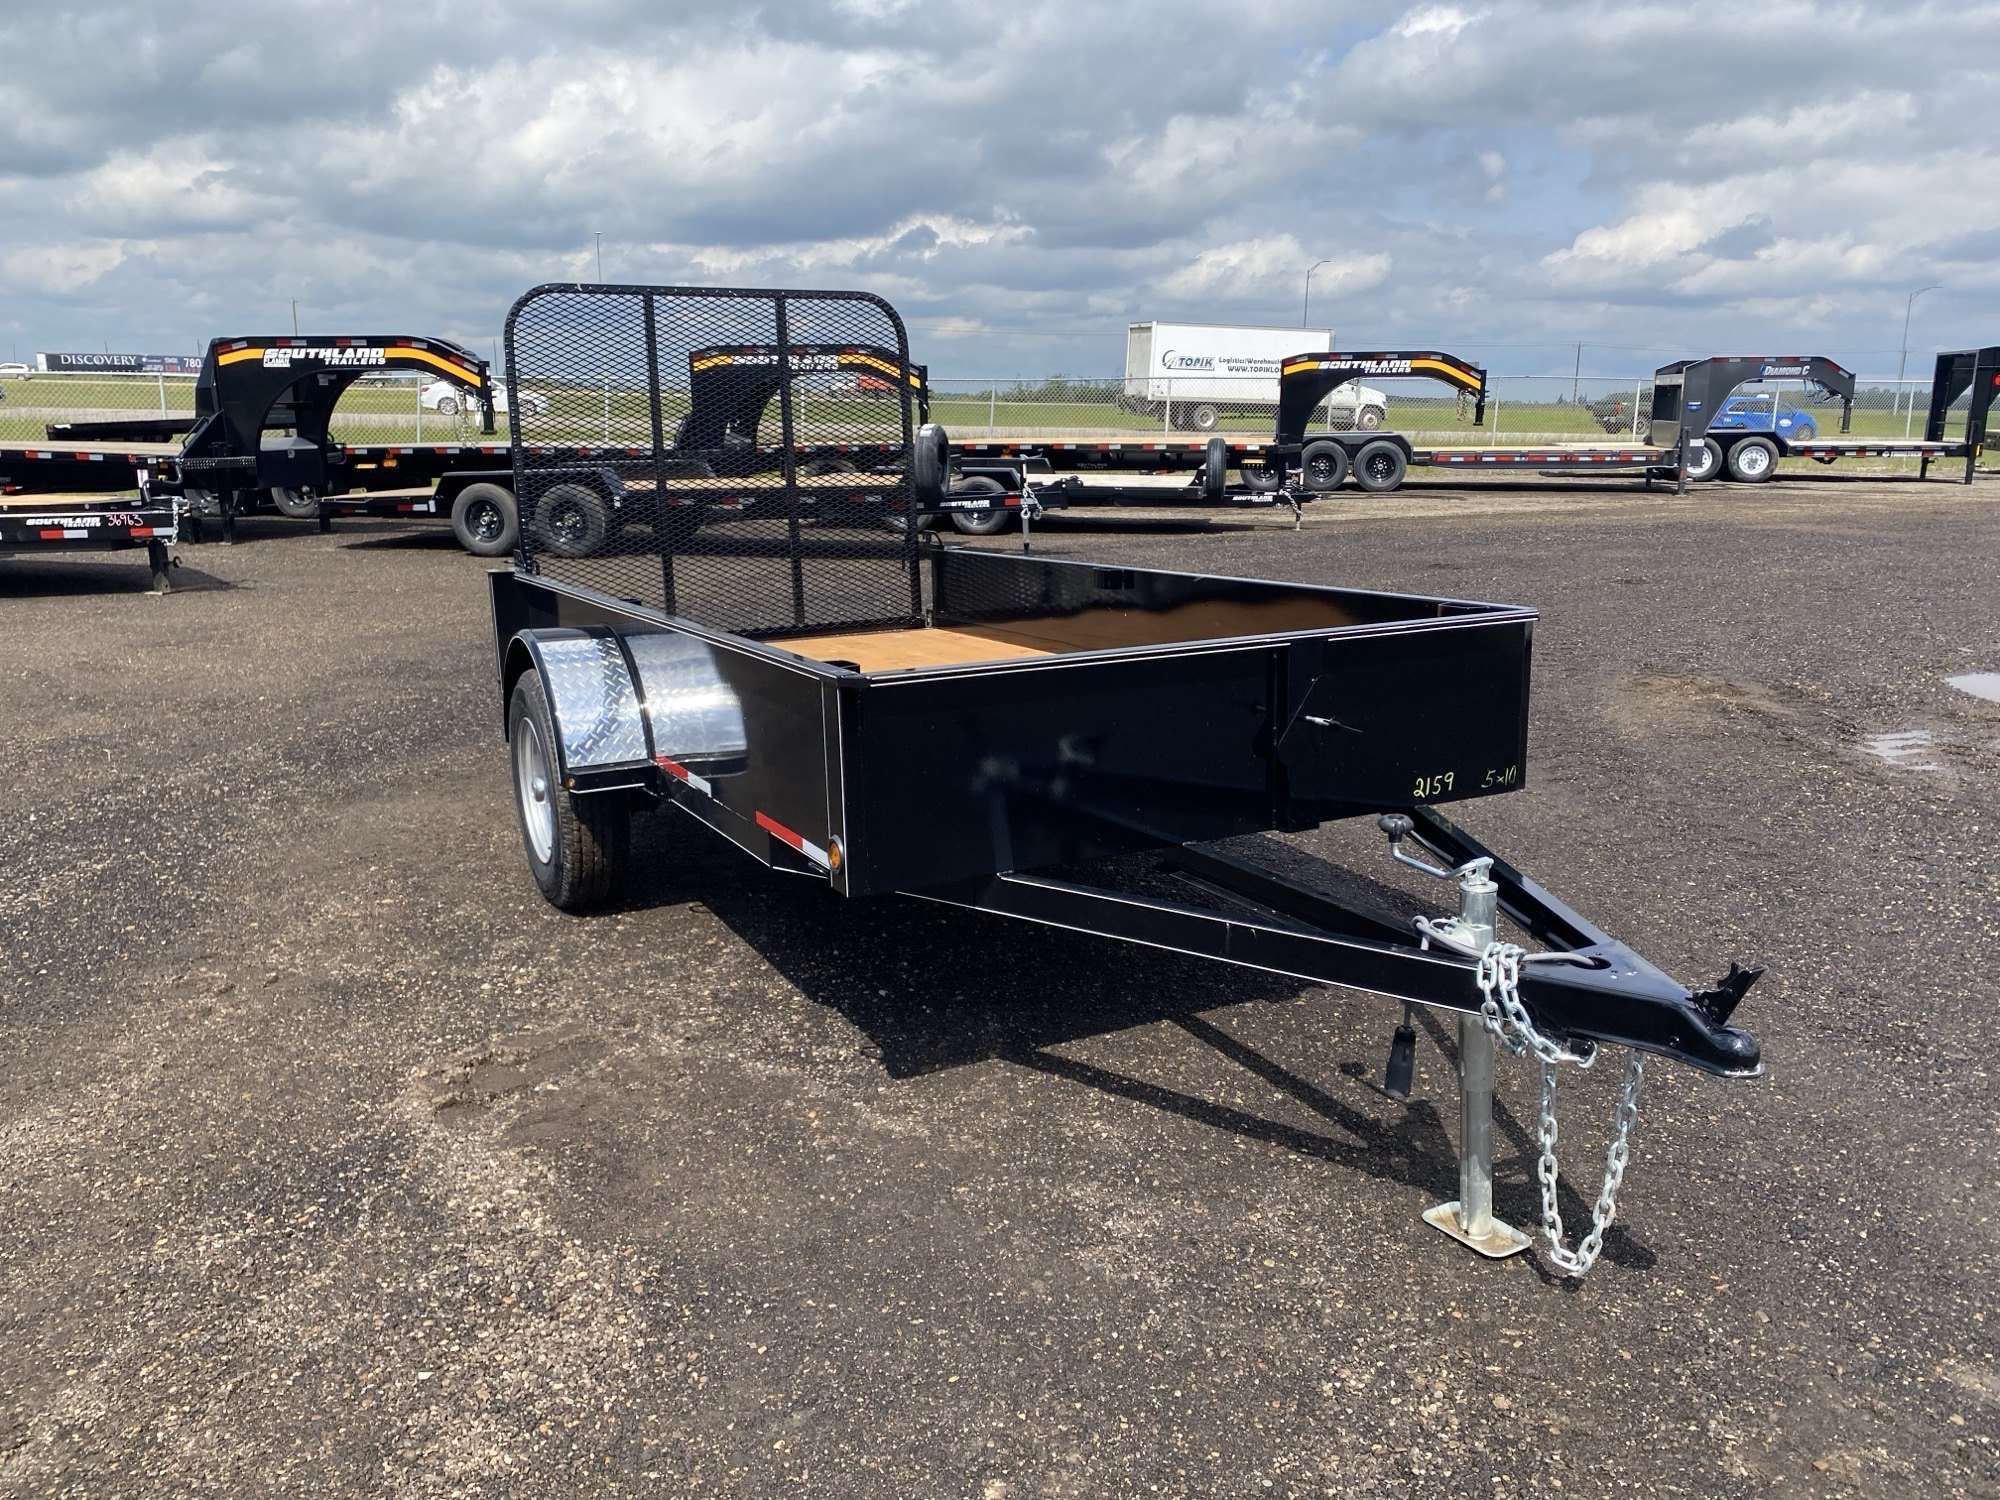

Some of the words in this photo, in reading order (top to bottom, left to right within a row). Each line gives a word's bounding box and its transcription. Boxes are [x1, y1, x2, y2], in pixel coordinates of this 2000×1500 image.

[264, 348, 385, 359] SOUTHLAND
[60, 354, 137, 366] DISCOVERY
[1179, 357, 1214, 368] TOPIK
[1219, 356, 1282, 365] Logistics/Warehousi
[1318, 360, 1412, 369] SOUTHLAND
[1228, 365, 1282, 373] WWW.TOPIKLO
[105, 514, 144, 527] 36963
[1413, 771, 1455, 798] 2159
